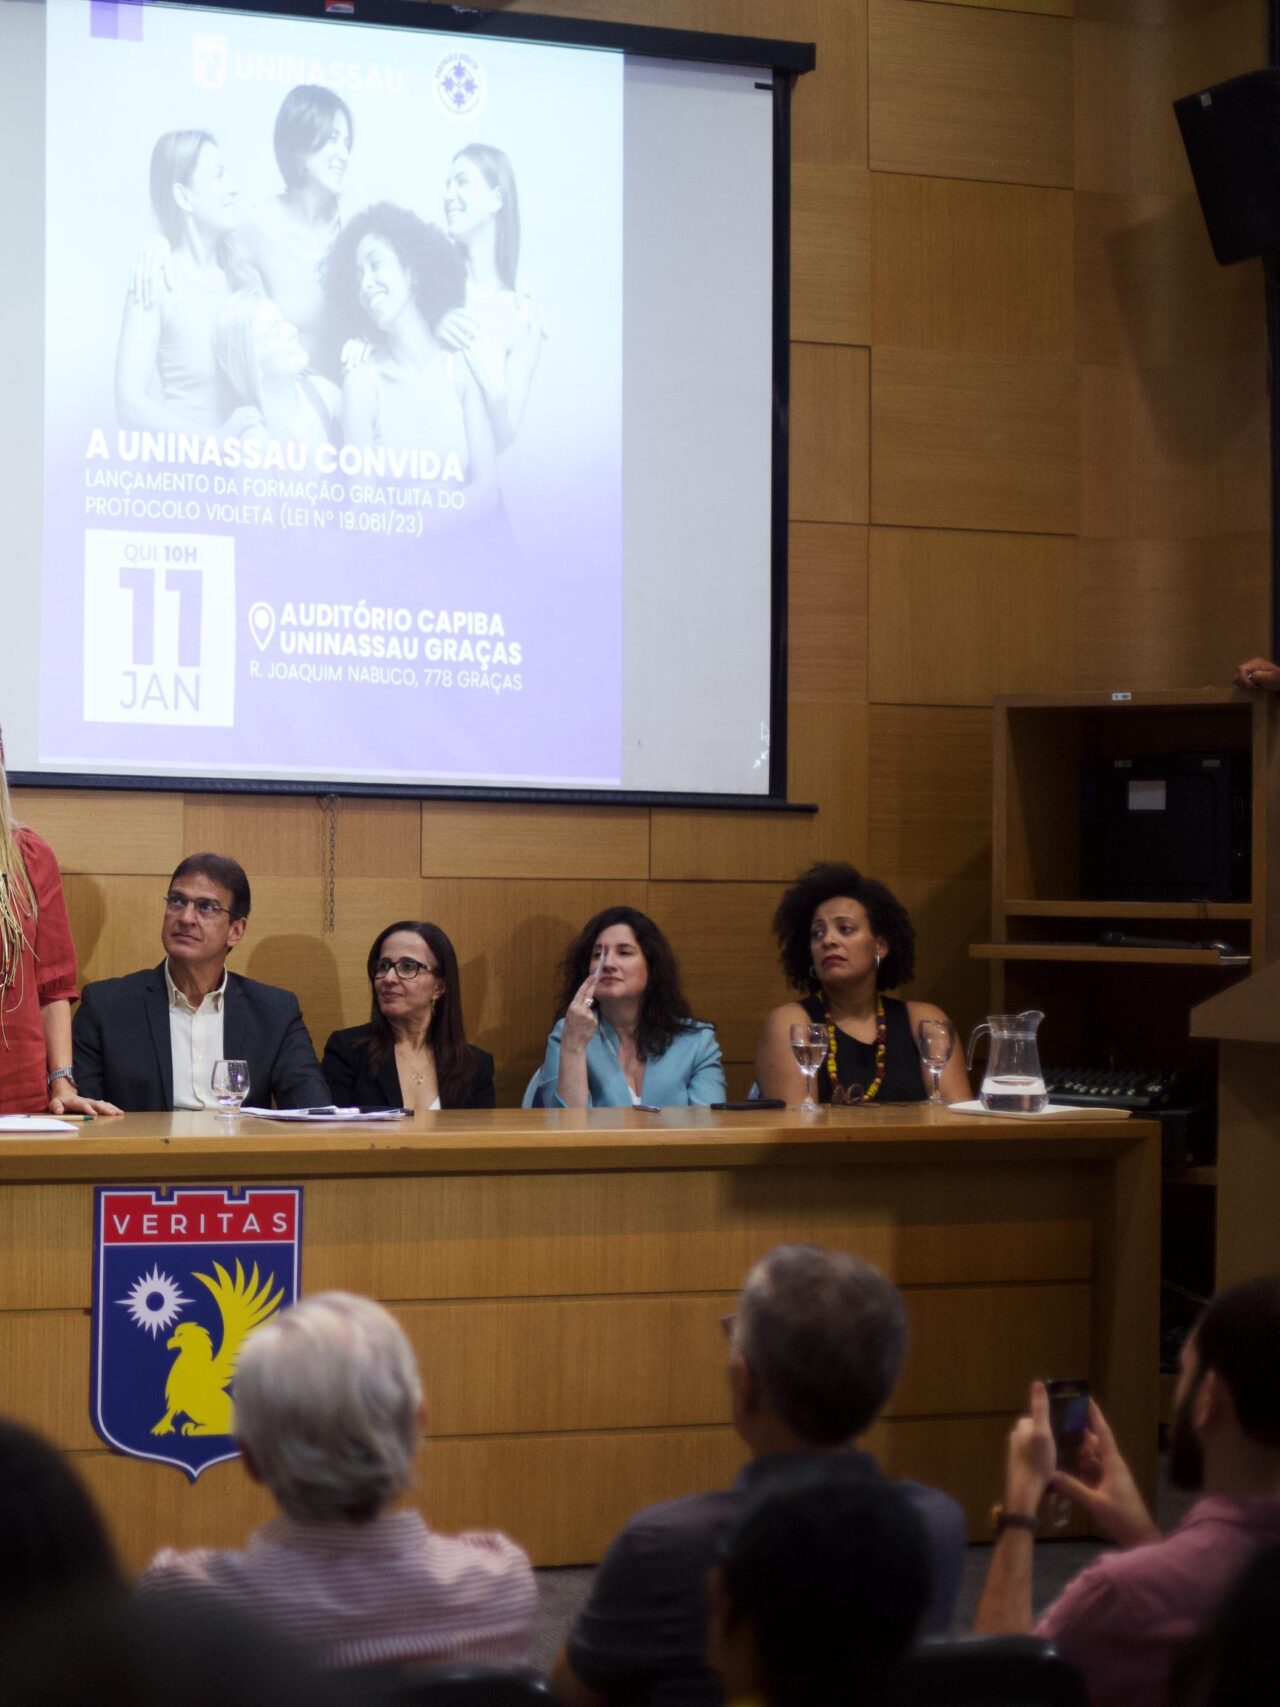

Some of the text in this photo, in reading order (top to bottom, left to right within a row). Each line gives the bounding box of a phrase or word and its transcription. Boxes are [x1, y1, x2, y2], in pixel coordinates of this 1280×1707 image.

[235, 53, 404, 94] UNINASSAU
[86, 429, 464, 482] A UNINASSAU CONVIDA
[85, 469, 465, 510] LANÇAMENTO DA FORMAÇÃO GRATUITA DO
[85, 497, 200, 521] PROTOCOLO
[206, 504, 274, 526] VIOLETA
[279, 508, 309, 532] (LEI
[338, 510, 424, 537] 19.061/23)
[124, 544, 197, 564] QUI 10H
[119, 567, 203, 668] 11
[280, 599, 504, 637] AUDITÓRIO CAPIBA
[280, 631, 522, 670] UNINASSAU GRAÇAS
[120, 670, 200, 712] JAN
[250, 659, 522, 694] R. JOAQUIM NABUCO, 778 GRAÇAS
[113, 1212, 287, 1235] VERITAS
